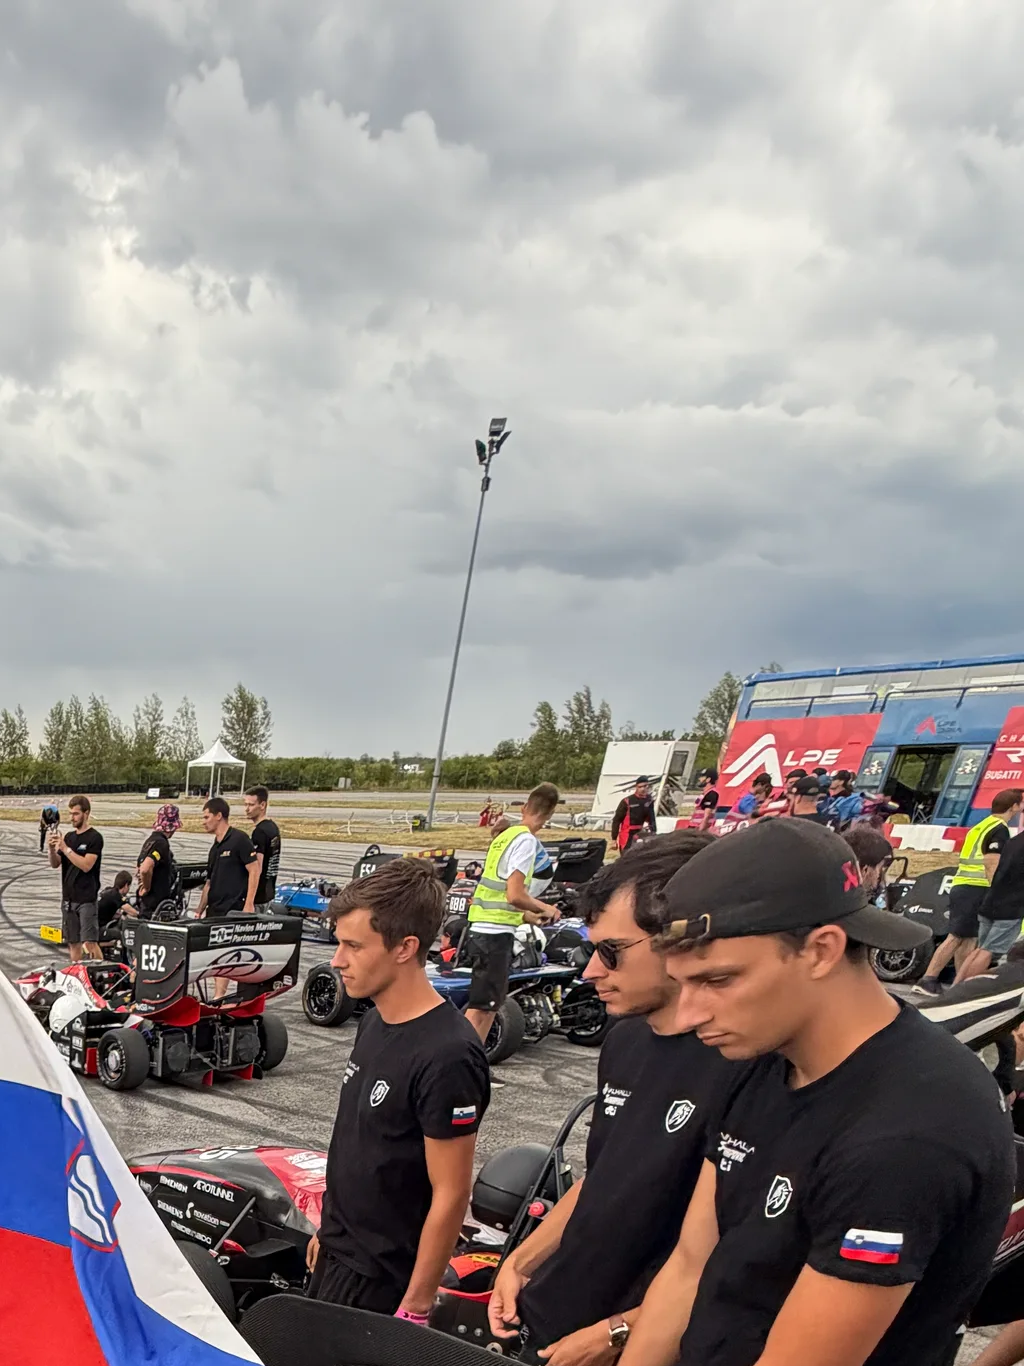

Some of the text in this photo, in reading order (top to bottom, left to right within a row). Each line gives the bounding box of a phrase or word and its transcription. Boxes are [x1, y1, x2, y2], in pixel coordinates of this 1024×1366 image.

[984, 770, 1022, 780] BUGATTI
[141, 944, 166, 972] E52
[157, 1200, 184, 1219] SIEMENS
